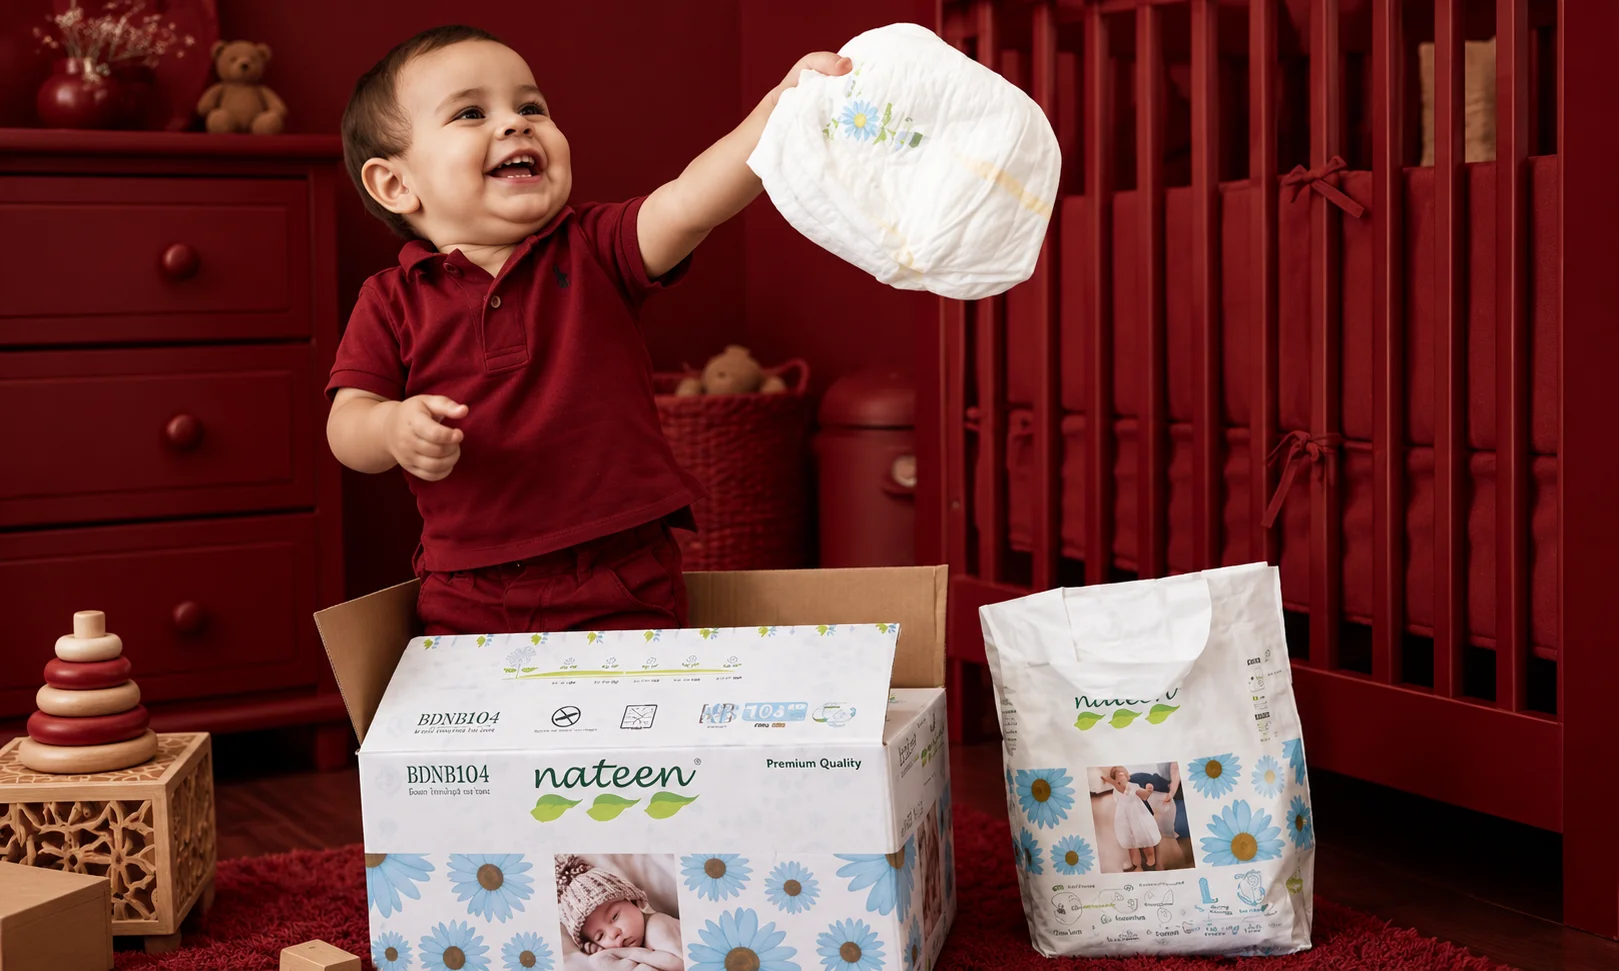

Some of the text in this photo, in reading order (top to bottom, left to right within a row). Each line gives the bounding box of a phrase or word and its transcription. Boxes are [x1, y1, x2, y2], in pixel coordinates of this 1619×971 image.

[417, 711, 501, 726] BDNB104
[766, 757, 862, 770] Premium Quality
[406, 764, 490, 784] BDNB104
[534, 758, 697, 789] nateen
